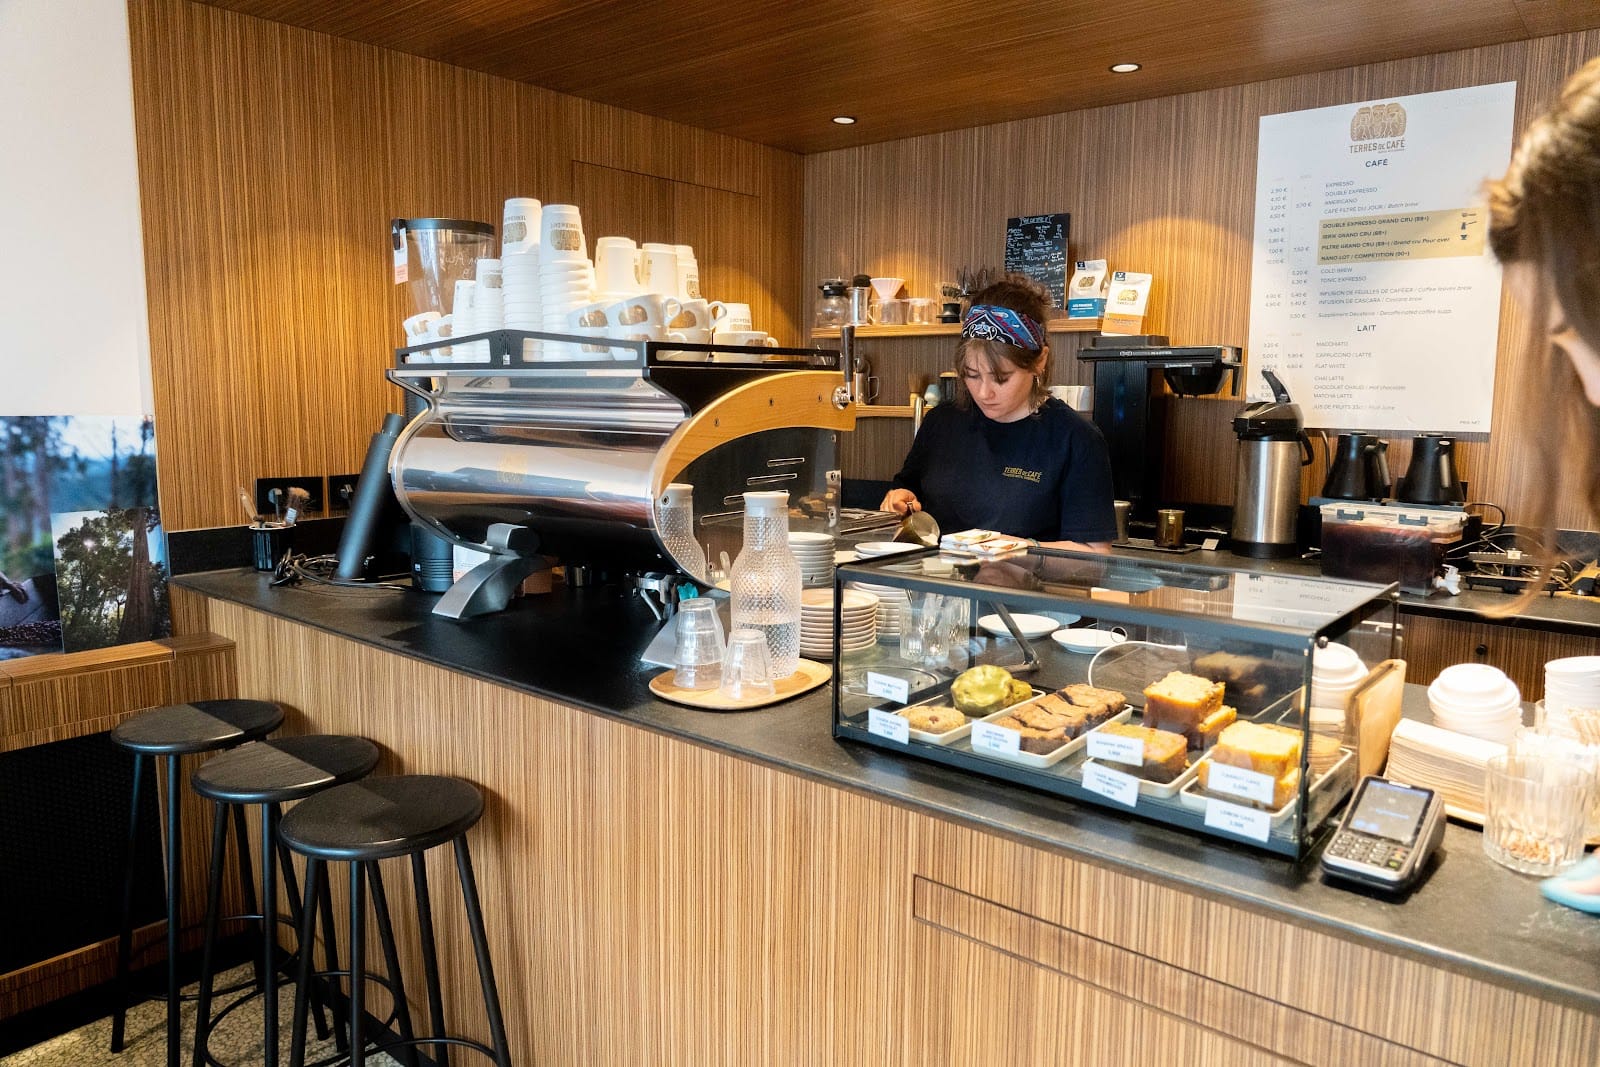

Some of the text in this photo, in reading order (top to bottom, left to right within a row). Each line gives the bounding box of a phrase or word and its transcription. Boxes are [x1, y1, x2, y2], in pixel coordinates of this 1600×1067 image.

[1349, 142, 1377, 154] TERRES
[1386, 137, 1406, 149] CAFÉ
[1365, 159, 1388, 168] CAFÉ
[1325, 180, 1355, 188] EXPRESSO
[1325, 189, 1347, 197] DOUBLE
[1357, 324, 1376, 332] LAIT
[1004, 467, 1022, 475] TERRES
[1220, 809, 1240, 818] LEMON
